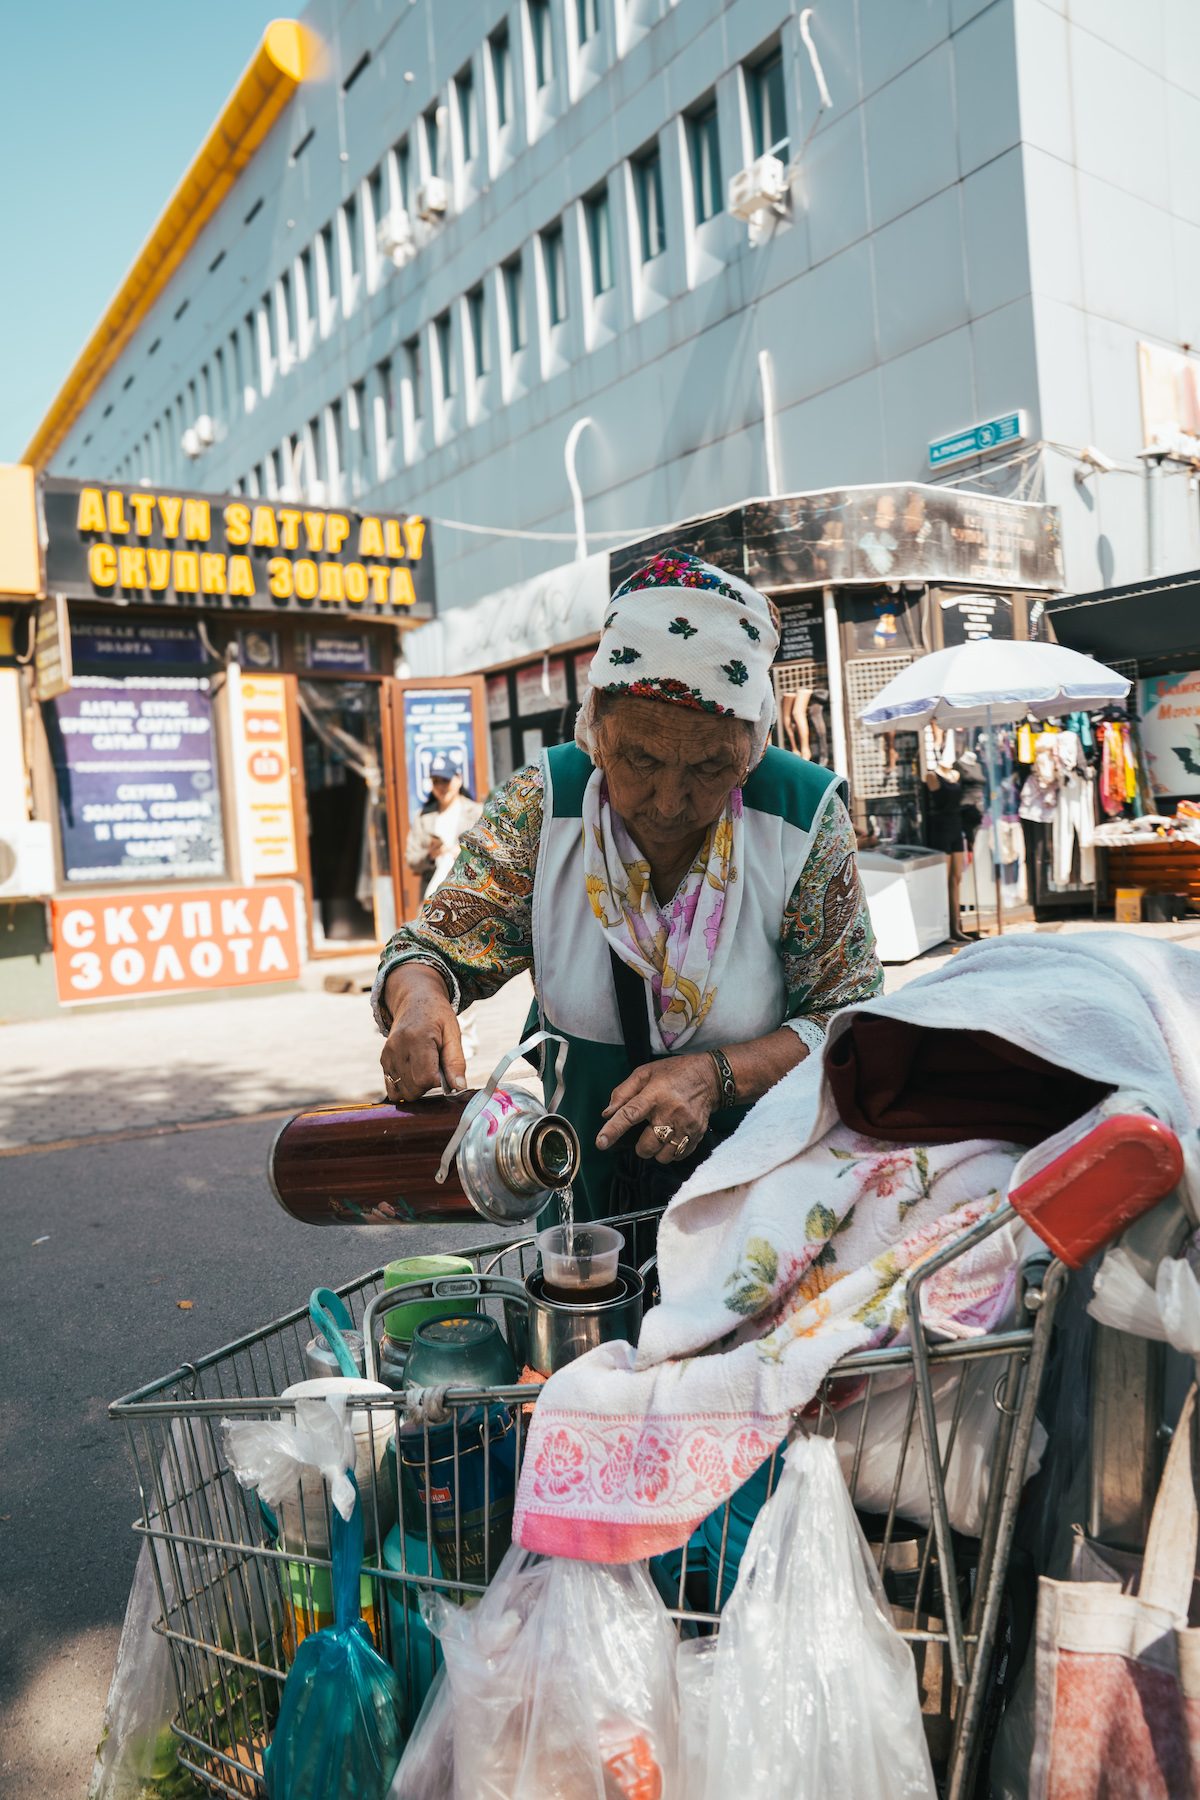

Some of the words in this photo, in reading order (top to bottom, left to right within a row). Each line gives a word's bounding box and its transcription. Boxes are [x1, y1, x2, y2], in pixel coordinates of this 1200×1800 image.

[77, 488, 211, 541] ALTYN
[225, 503, 350, 553] SATYP
[88, 543, 256, 596] СКУПКА
[267, 556, 417, 605] ЗОЛОТА
[95, 641, 152, 654] ЗОЛОТА
[116, 783, 177, 801] СКУПКА
[61, 896, 289, 948] СКУПКА
[69, 935, 289, 990] ЗОЛОТА
